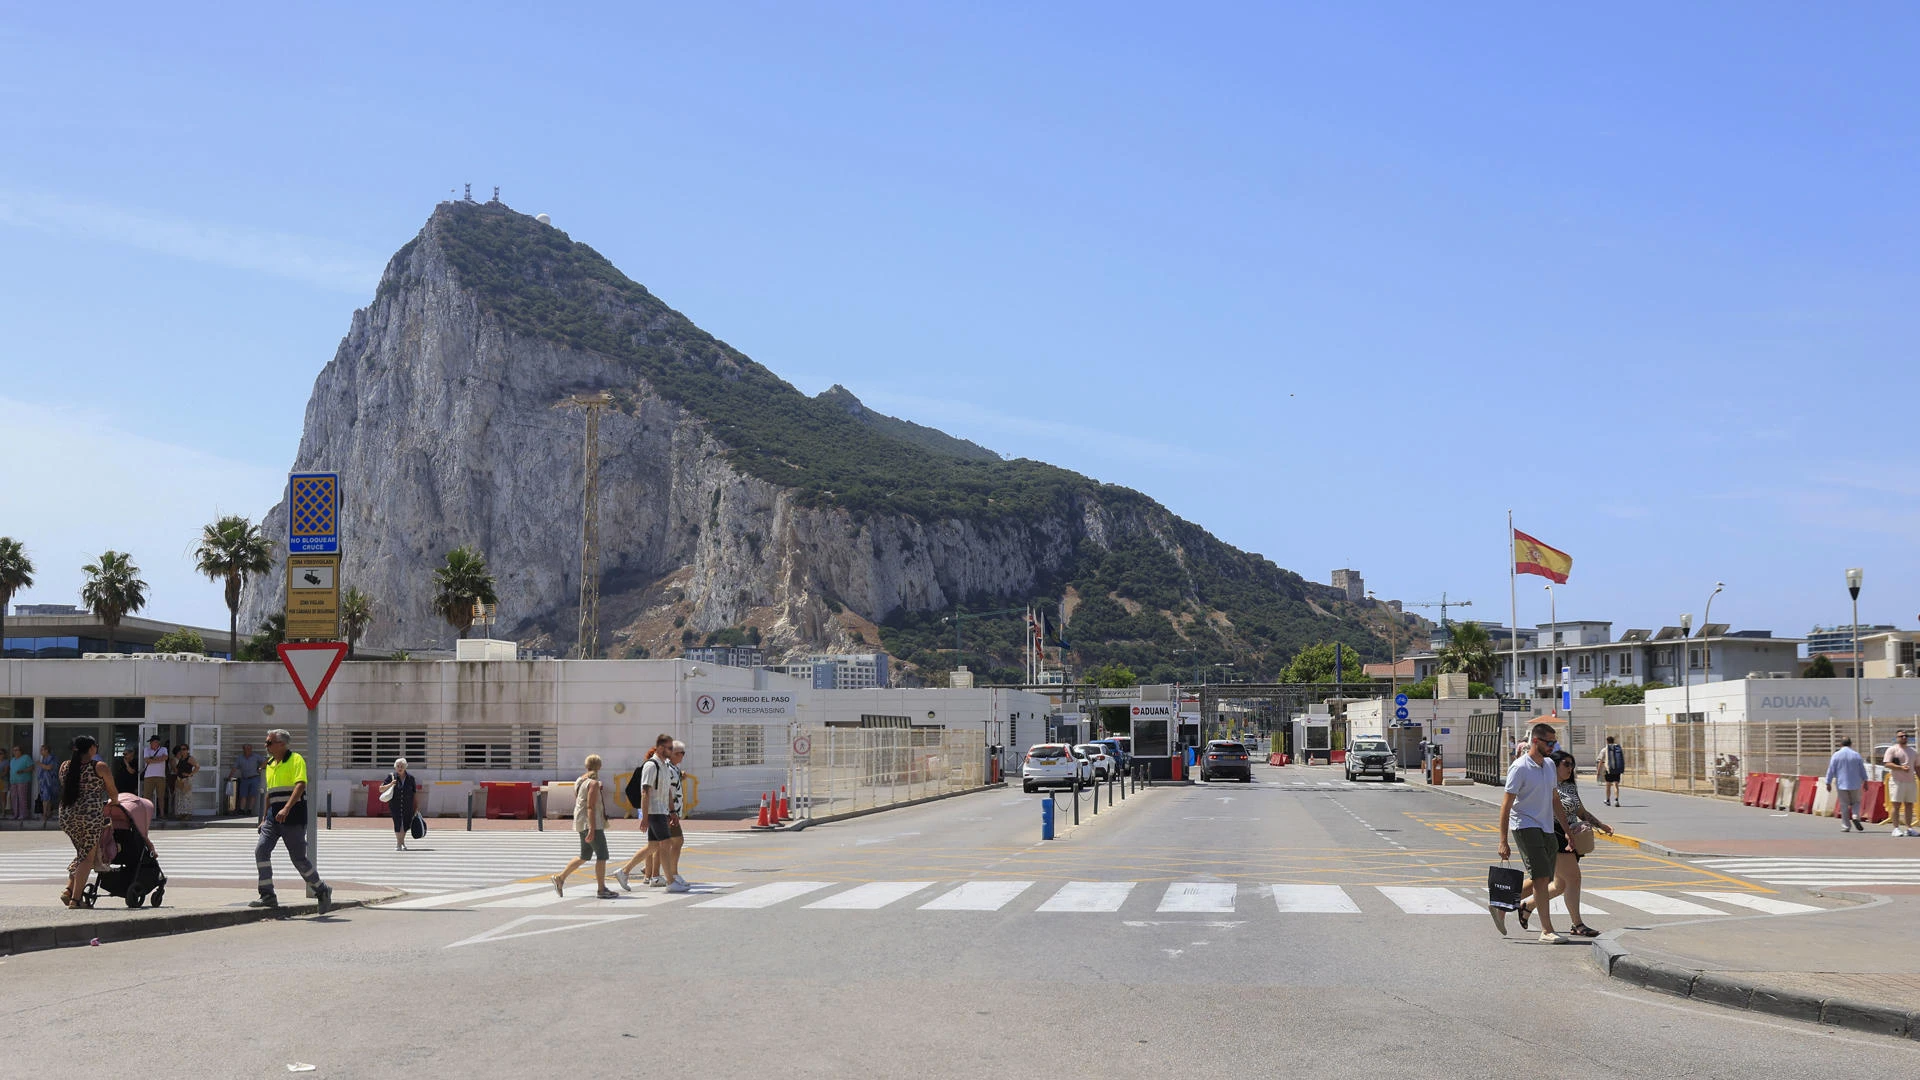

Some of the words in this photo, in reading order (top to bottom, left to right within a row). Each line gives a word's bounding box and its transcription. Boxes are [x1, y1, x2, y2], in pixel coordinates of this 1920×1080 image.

[302, 536, 336, 544] BLOQUEAR
[1760, 695, 1831, 708] ADUANA
[1140, 706, 1170, 715] ADUANA
